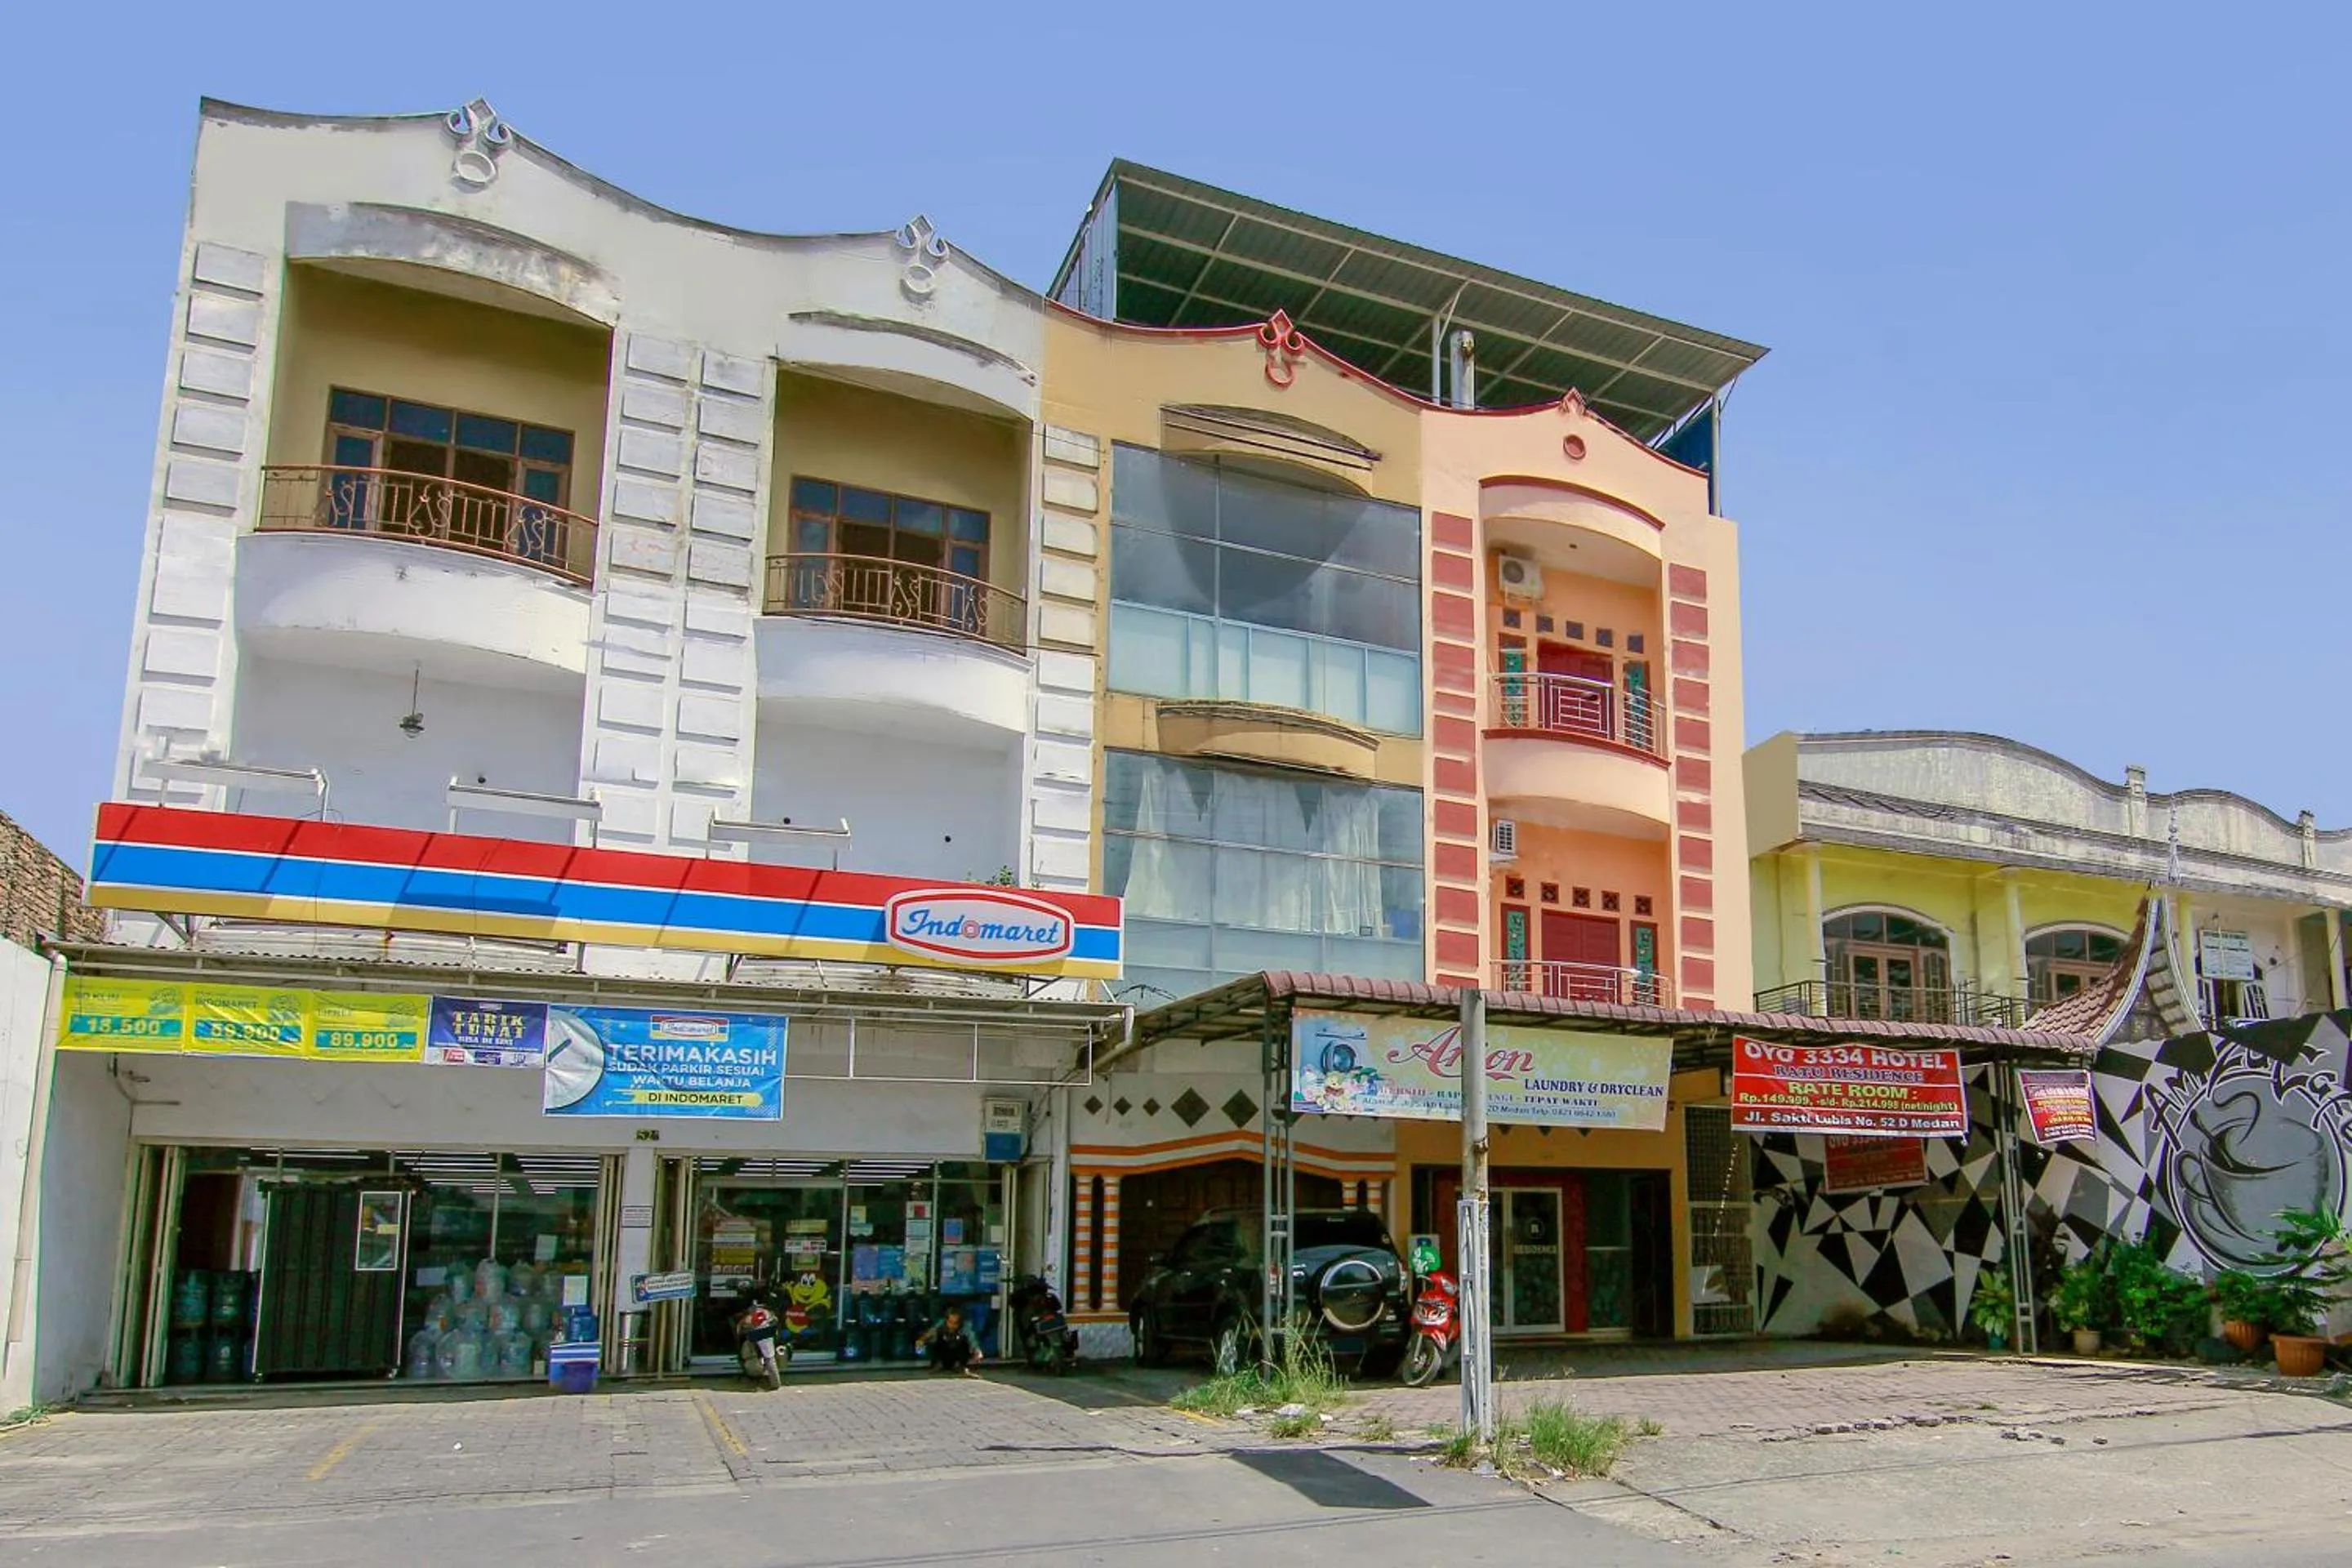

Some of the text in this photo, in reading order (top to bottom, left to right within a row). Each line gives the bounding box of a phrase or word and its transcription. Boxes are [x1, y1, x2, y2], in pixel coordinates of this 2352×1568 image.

[901, 908, 1059, 945] Indomaret
[452, 1011, 524, 1027] TARIK
[607, 1044, 777, 1065] TERIMAKASIH
[1744, 1041, 1948, 1069] OYO 3334 HOTEL
[662, 1064, 712, 1074] PARKIR
[715, 1066, 765, 1076] SESUAI
[1774, 1064, 1925, 1083] RATU RESIDENCE
[688, 1076, 752, 1088] BELANJA
[1524, 1077, 1586, 1094] LAUNDRY
[1600, 1082, 1665, 1097] DRYCLEAN
[1788, 1081, 1844, 1095] RATE
[1847, 1085, 1909, 1100] ROOM
[648, 1093, 744, 1105] DI INDOMARET
[1855, 1116, 1877, 1126] No.
[1880, 1117, 1895, 1126] 52
[1899, 1118, 1908, 1127] D
[1910, 1119, 1960, 1129] Medan
